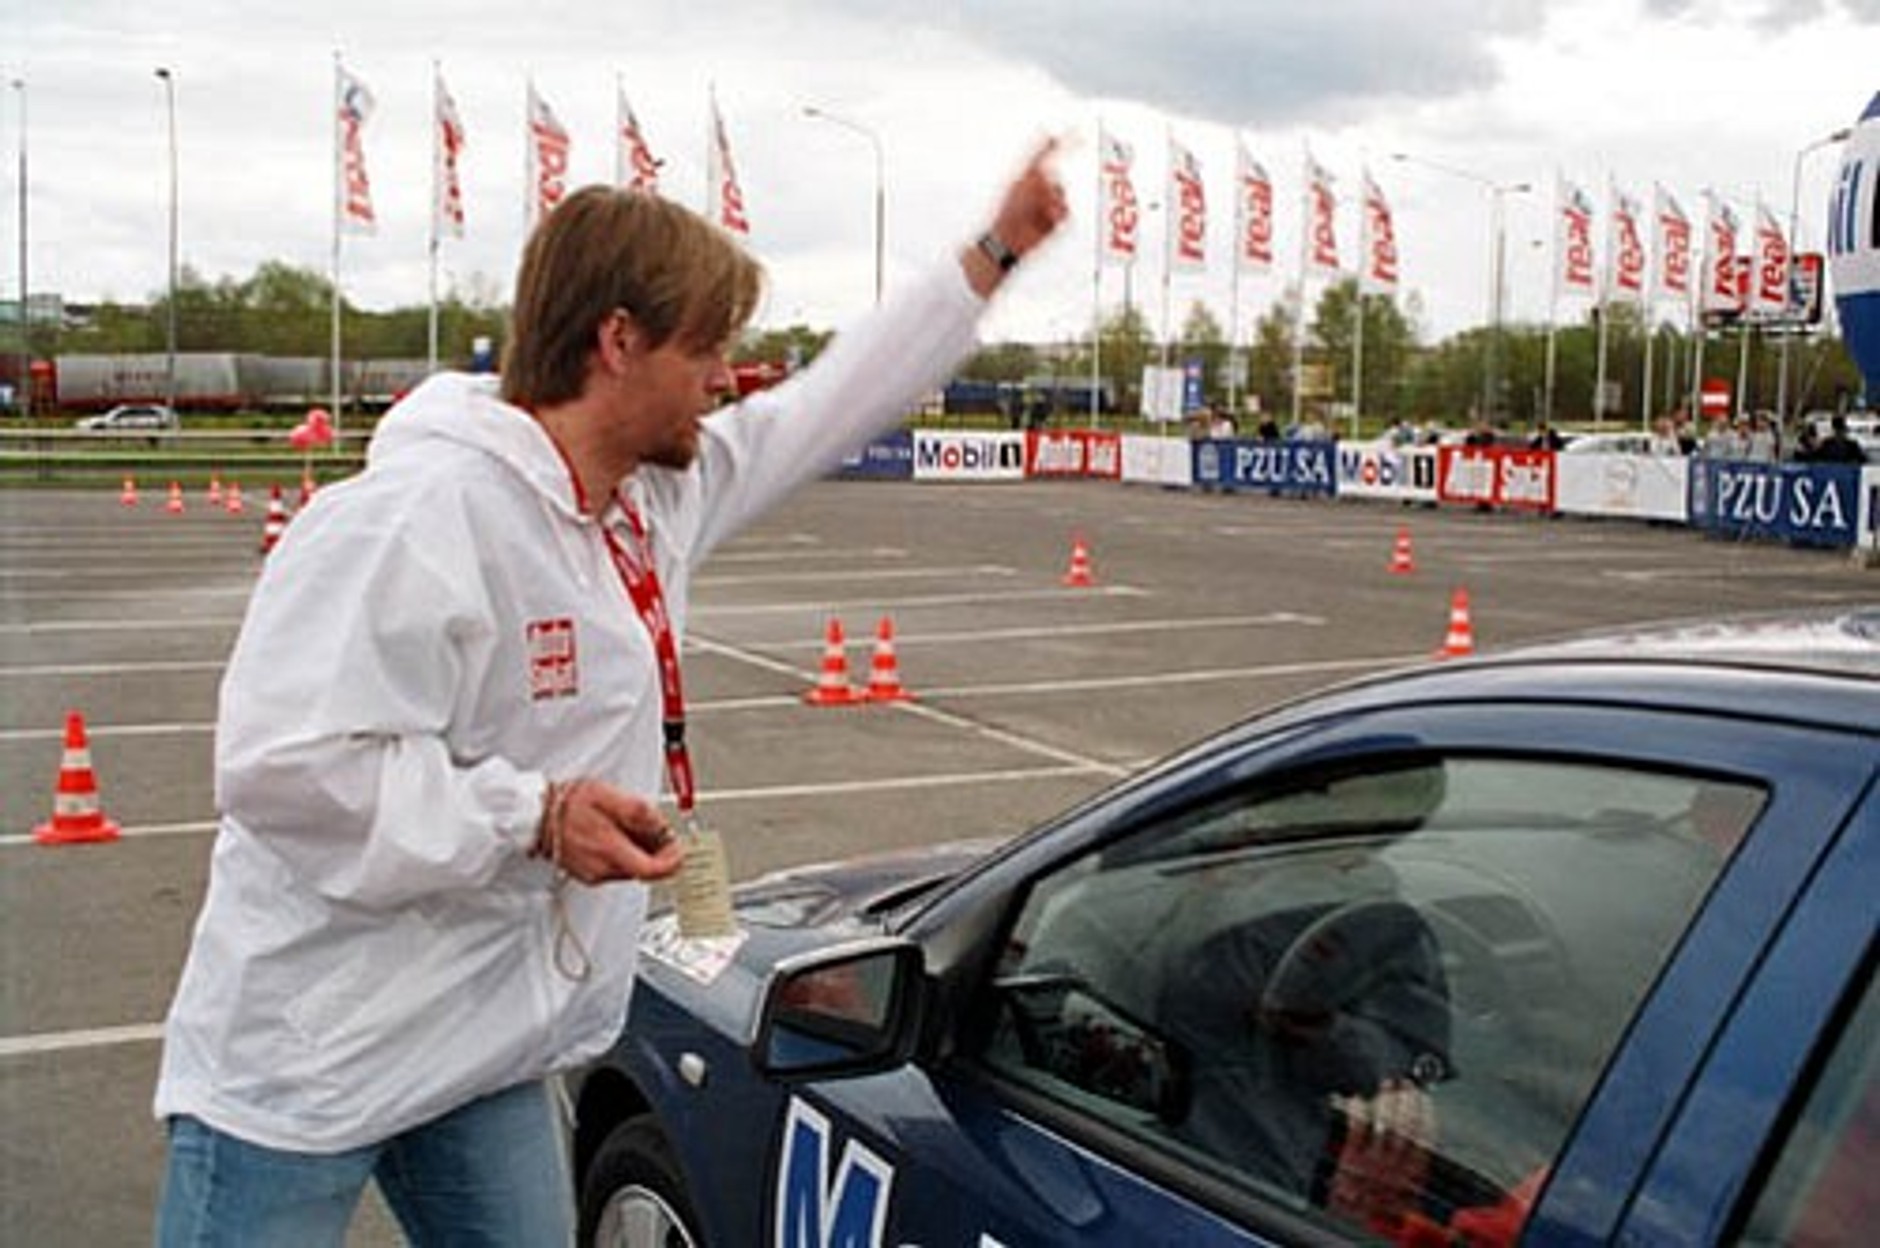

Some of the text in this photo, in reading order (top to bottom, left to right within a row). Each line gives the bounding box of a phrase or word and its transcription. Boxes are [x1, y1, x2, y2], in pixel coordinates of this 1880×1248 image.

[532, 124, 569, 208] eal
[1104, 163, 1137, 254] real
[1175, 171, 1205, 262] real
[1243, 175, 1272, 263] real
[1563, 207, 1592, 285] real
[1613, 210, 1644, 290] real
[1660, 213, 1690, 291] real
[1759, 225, 1787, 303] real
[918, 438, 996, 470] Mobil
[1235, 446, 1330, 483] PZU SA
[1717, 470, 1783, 523] PZU
[1790, 477, 1848, 531] SA
